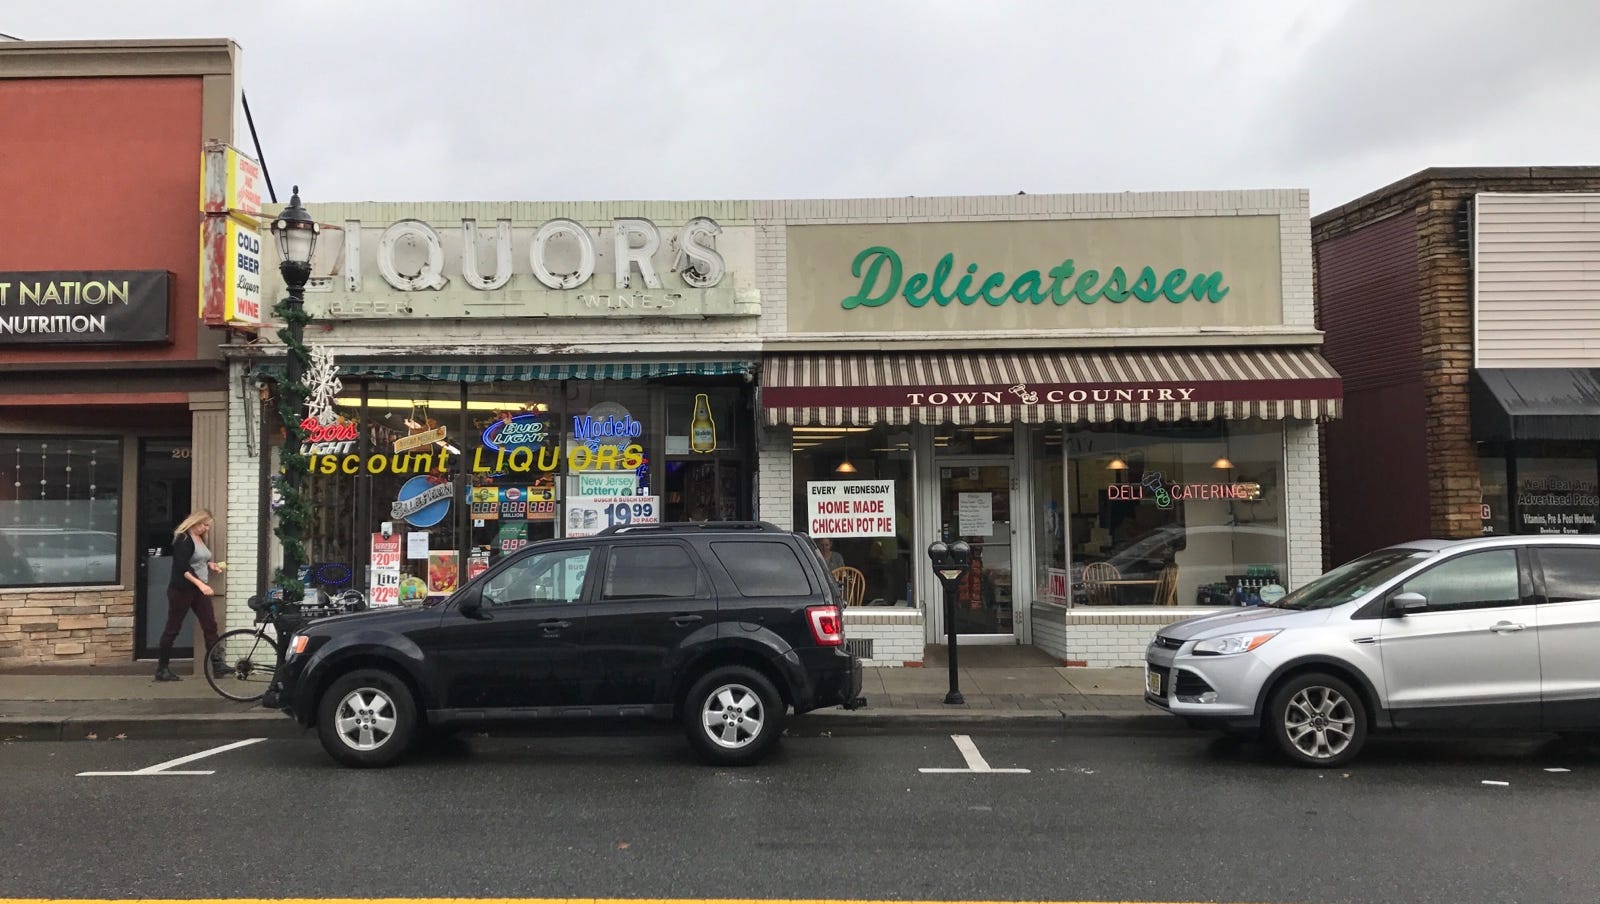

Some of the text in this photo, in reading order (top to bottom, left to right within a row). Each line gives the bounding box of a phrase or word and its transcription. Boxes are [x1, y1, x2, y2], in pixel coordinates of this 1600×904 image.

[237, 231, 260, 255] COLD
[237, 252, 260, 275] BEER
[841, 246, 1230, 310] Delicatessen
[19, 280, 129, 306] NATION
[237, 297, 259, 319] WINE
[582, 294, 677, 309] WINES
[0, 314, 106, 335] NUTRITION
[907, 391, 1003, 405] TOWN
[1046, 387, 1196, 402] COUNTRY
[299, 416, 358, 442] Coors
[502, 422, 543, 435] BUD
[572, 414, 643, 441] Modelo
[493, 432, 549, 445] LIGHT
[171, 447, 192, 459] 20
[299, 440, 357, 456] LIGHT
[281, 448, 450, 475] iscount
[472, 444, 644, 473] LIQUORS
[581, 475, 634, 487] New Jersey
[581, 486, 619, 496] Lottery
[811, 485, 890, 495] EVERY WEDNESDAY
[1108, 484, 1143, 500] DELI
[1171, 484, 1249, 500] CATERING
[817, 500, 884, 514] HOME MADE
[1517, 493, 1571, 506] Advertised
[812, 517, 892, 534] CHICKEN POT PIE
[376, 573, 398, 587] Lite
